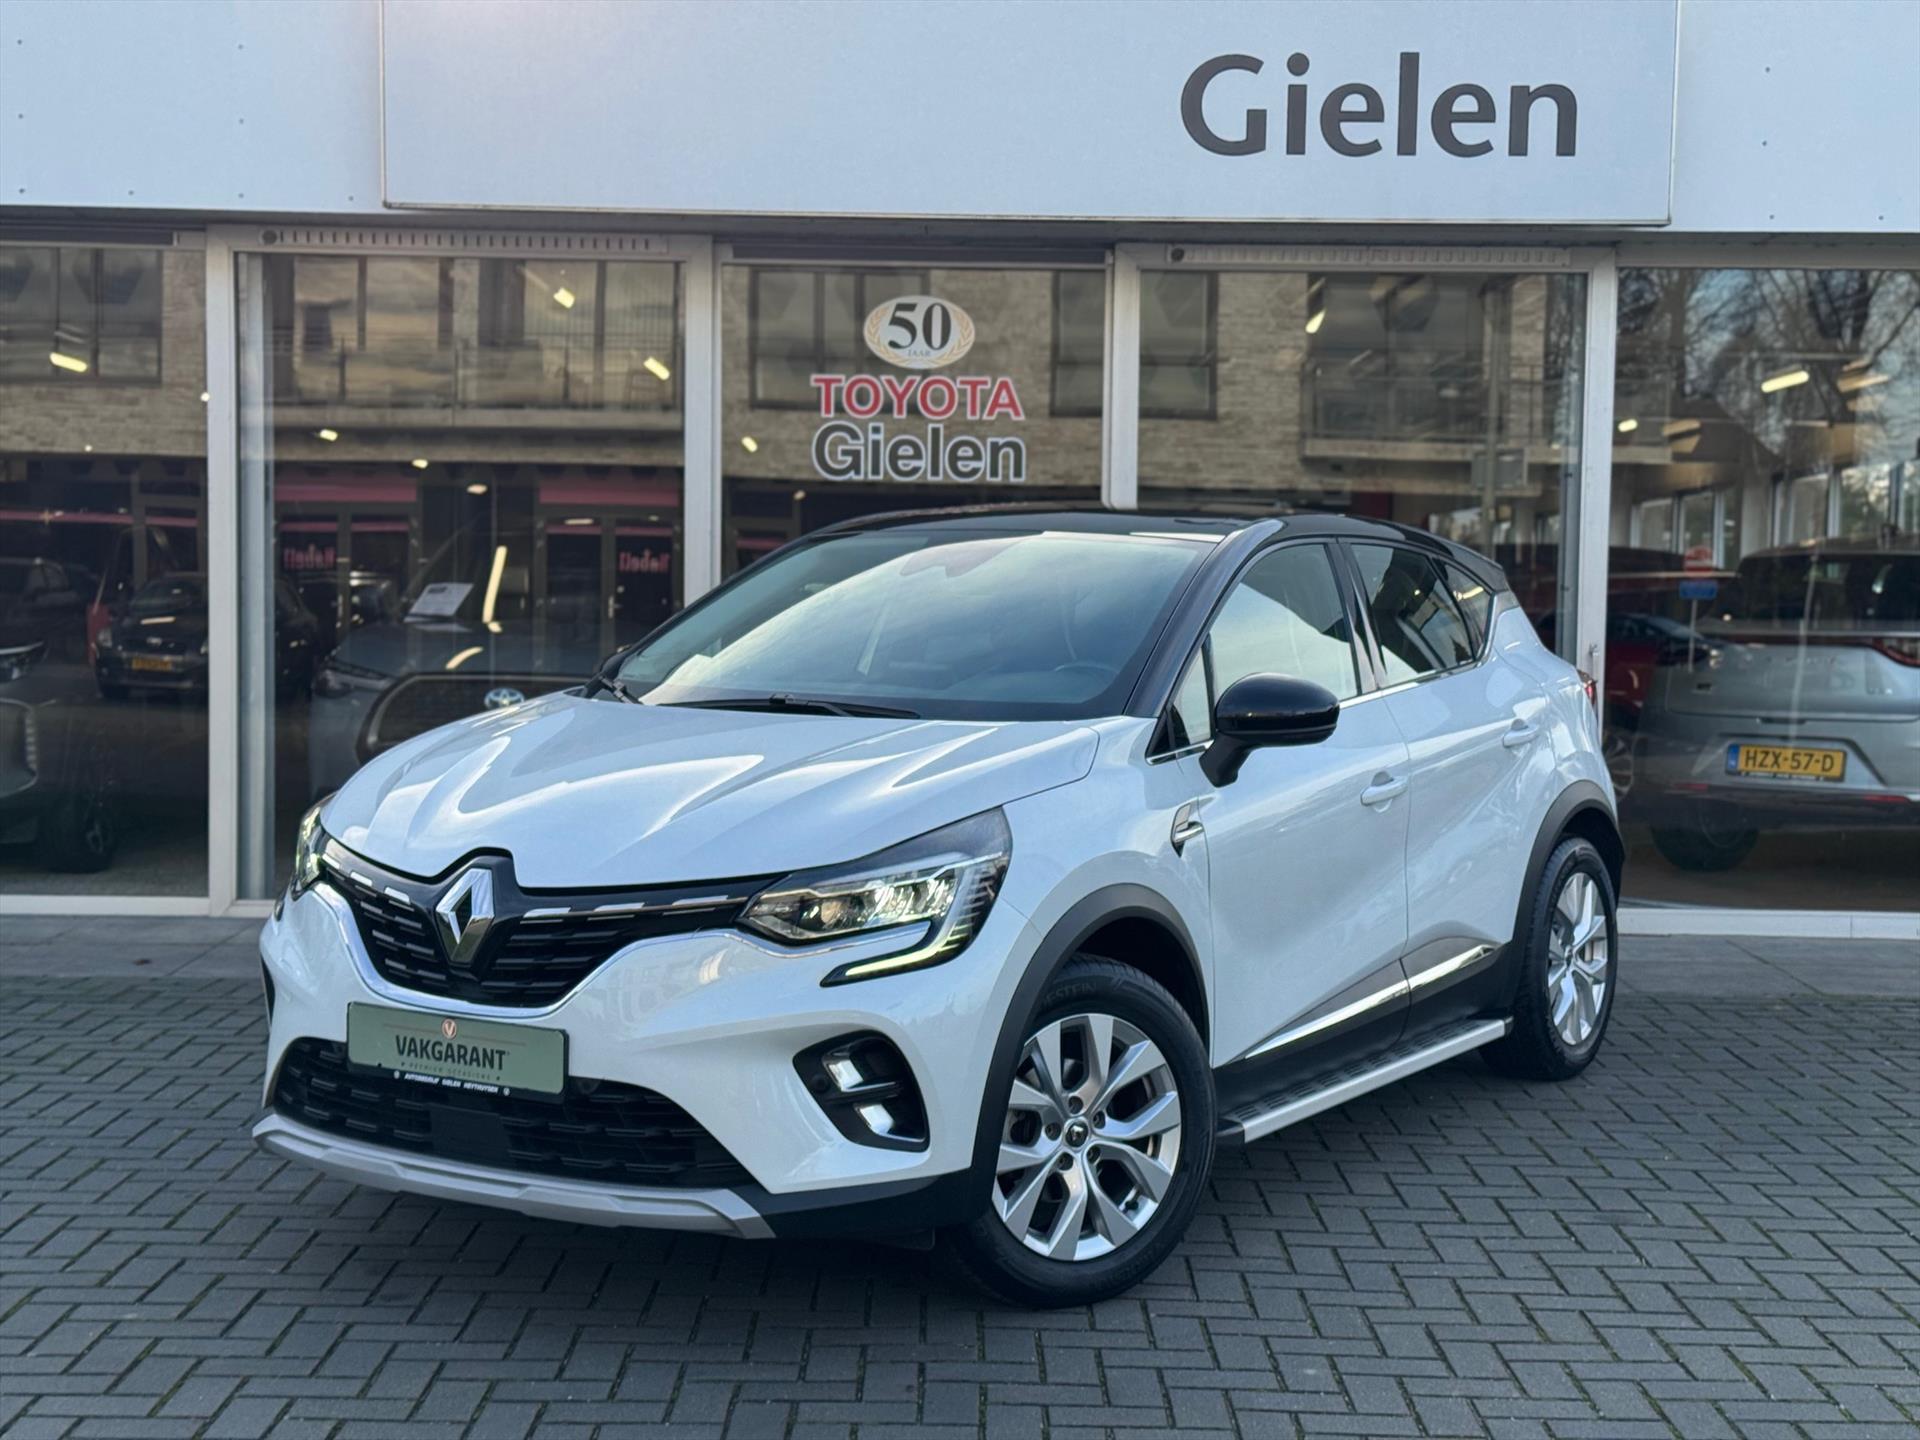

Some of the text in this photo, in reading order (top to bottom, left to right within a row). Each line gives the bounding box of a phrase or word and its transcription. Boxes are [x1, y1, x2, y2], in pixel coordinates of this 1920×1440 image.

[1181, 52, 1577, 158] Gielen
[887, 302, 952, 351] 50
[811, 375, 1025, 420] TOYOTA
[812, 421, 1026, 482] Gielen
[1744, 749, 1835, 772] HZX-57-D
[395, 1034, 507, 1070] VAKGARANT
